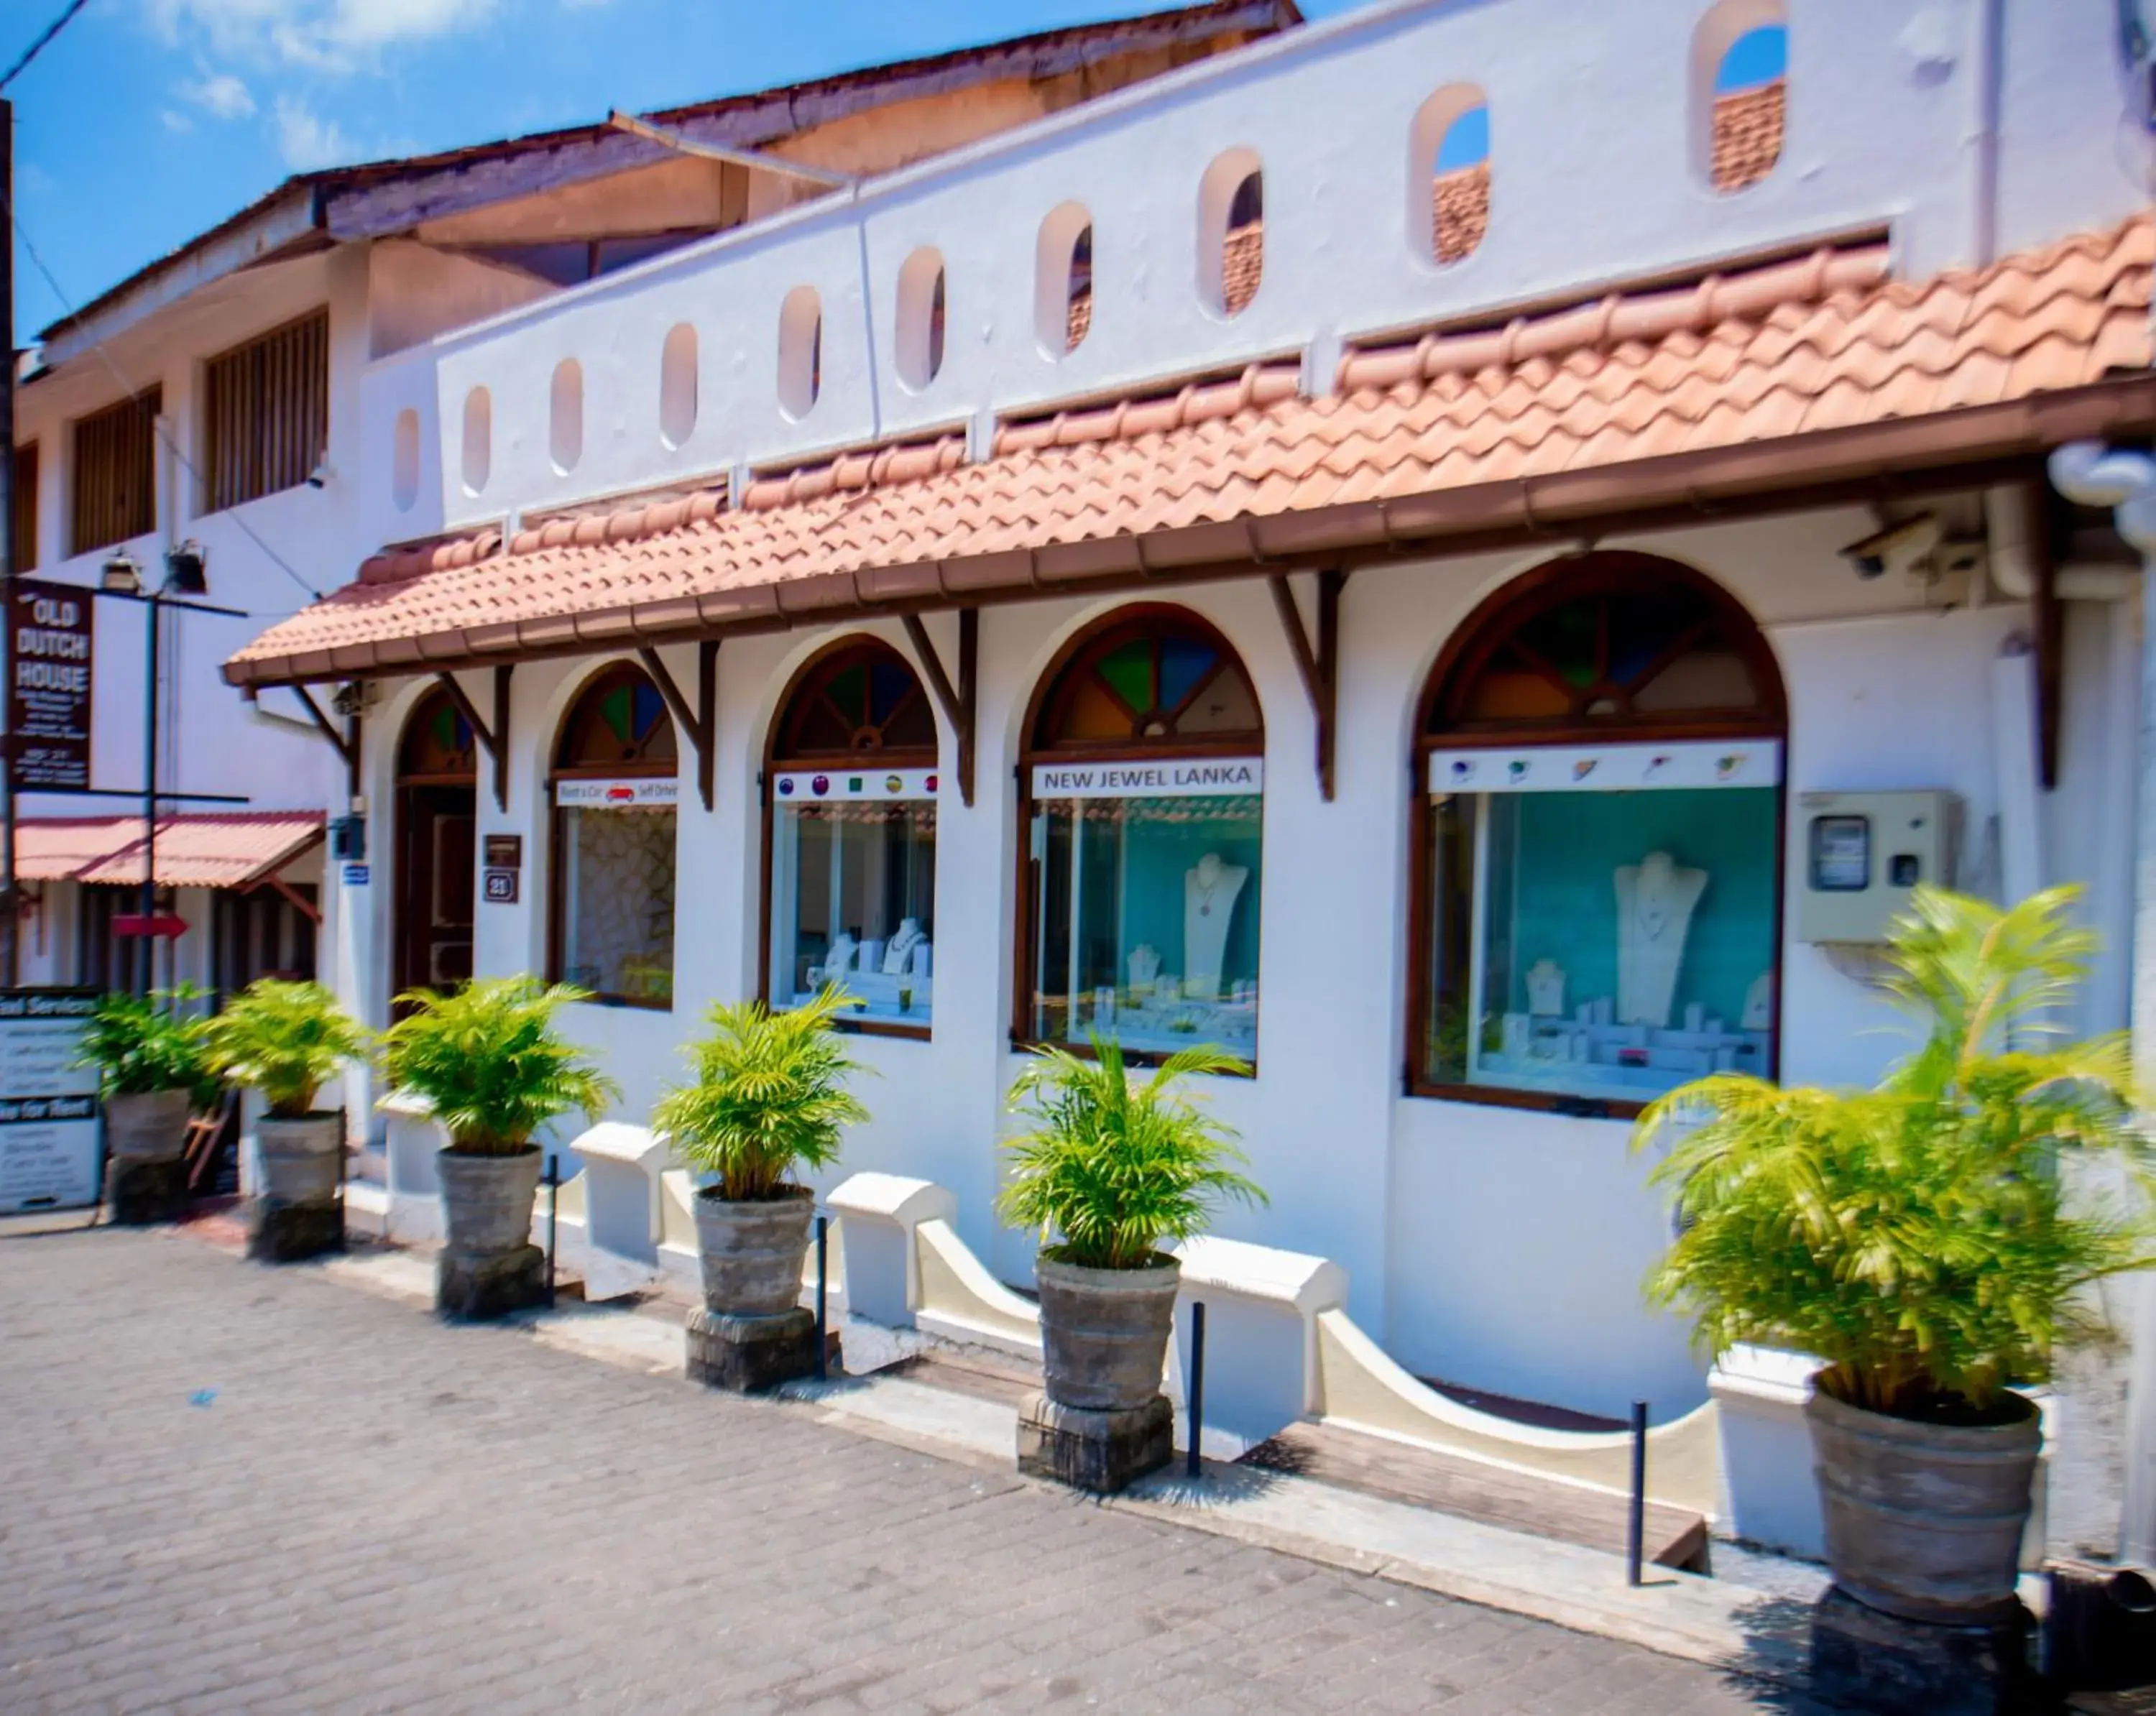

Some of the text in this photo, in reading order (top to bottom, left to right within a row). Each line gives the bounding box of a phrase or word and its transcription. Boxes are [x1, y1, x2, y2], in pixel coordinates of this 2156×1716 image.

[33, 598, 78, 627] OLD
[17, 627, 89, 659] DUTCH
[16, 661, 88, 691] HOUSE
[1045, 765, 1252, 790] NEW JEWEL LANKA
